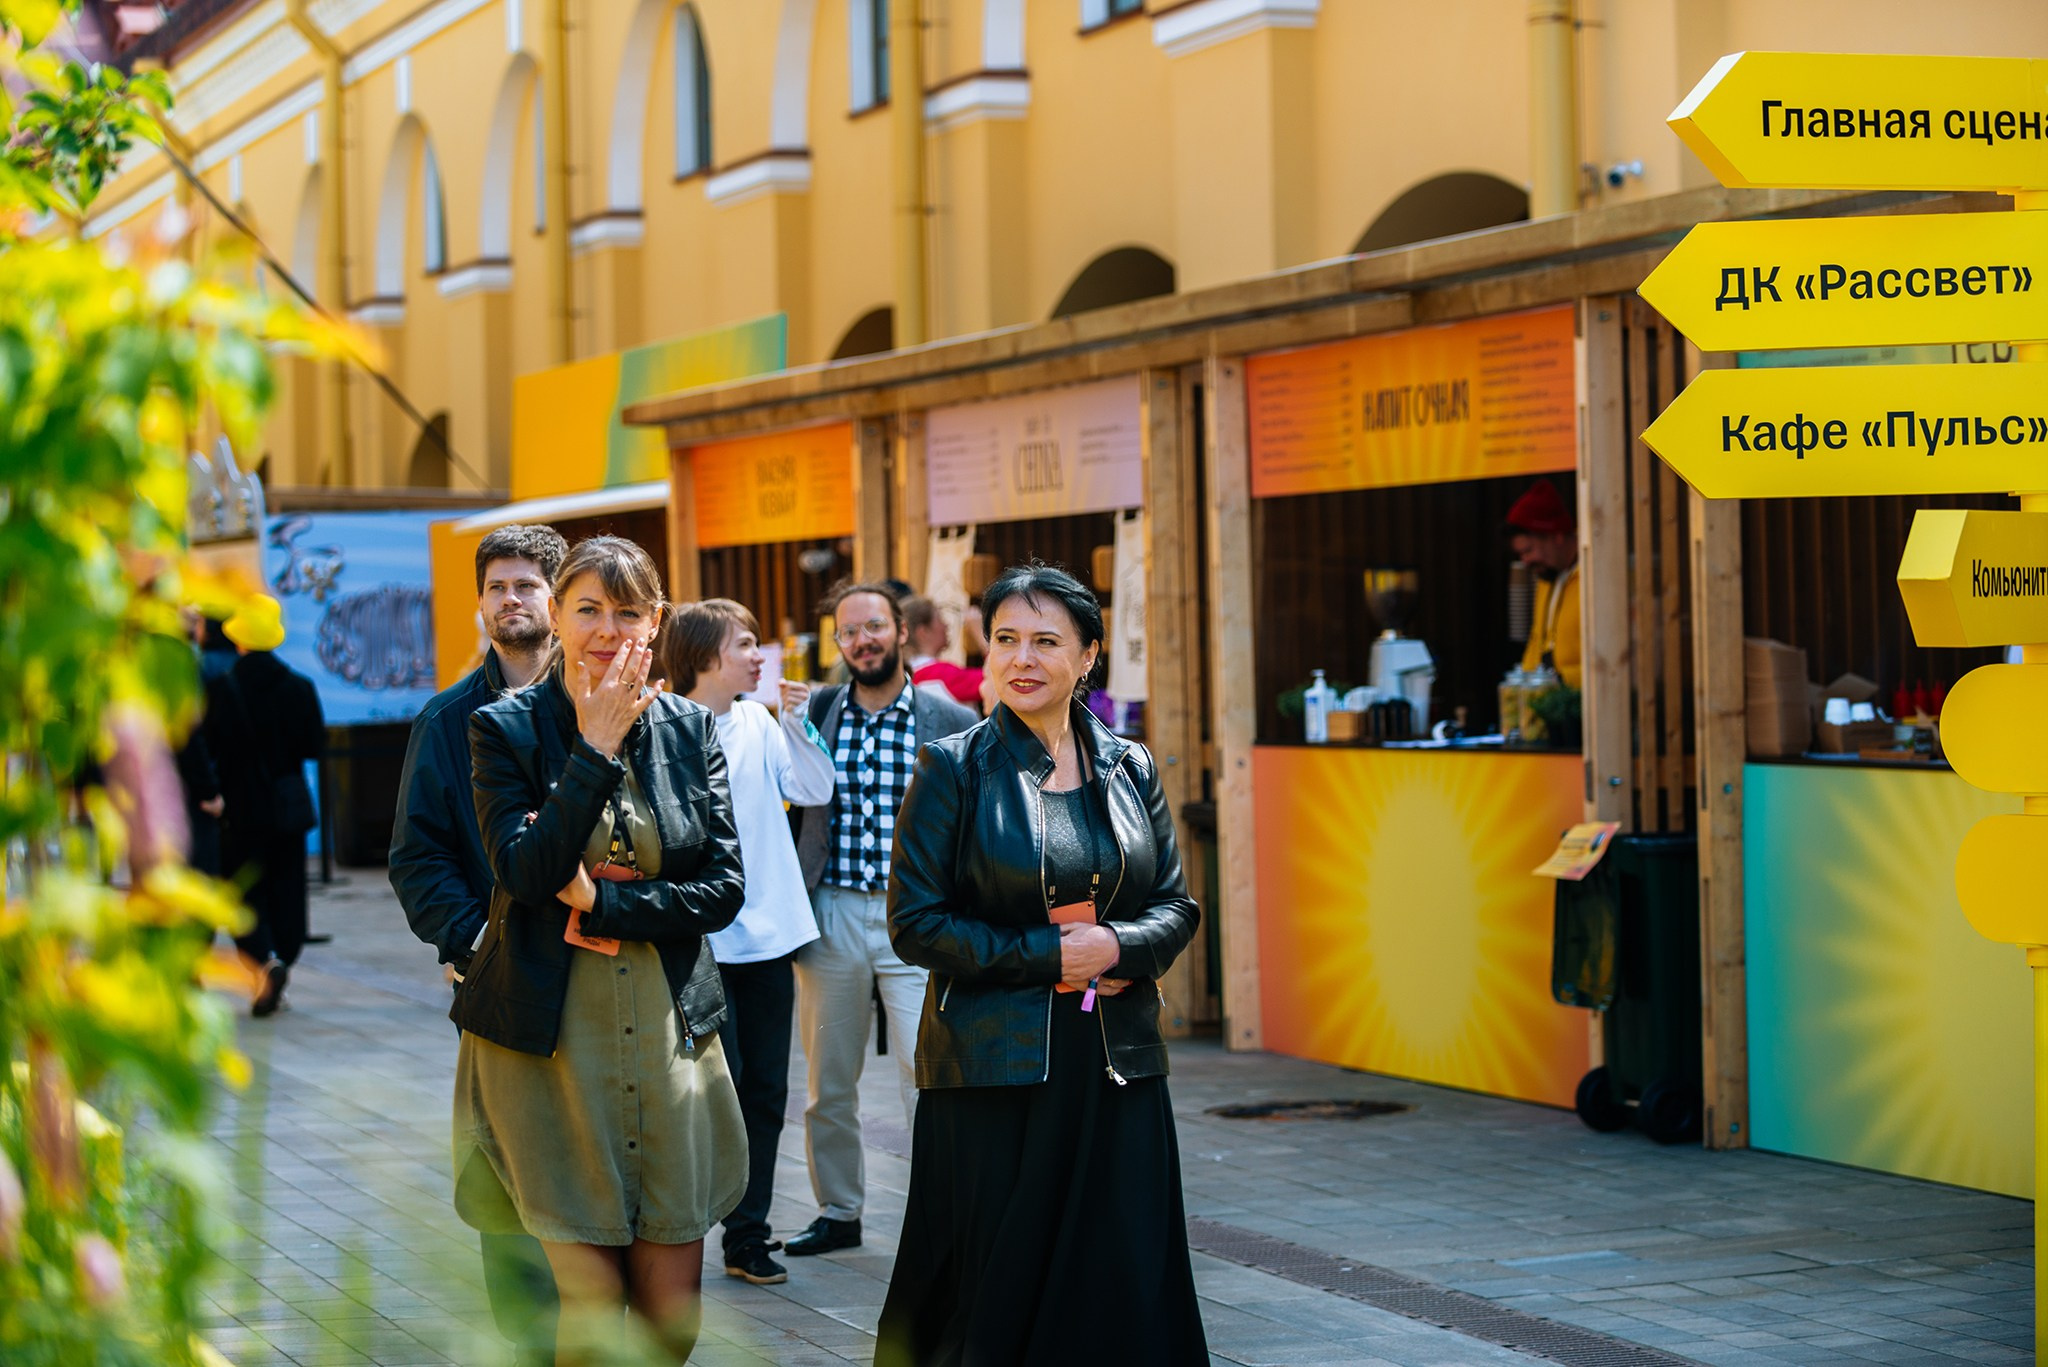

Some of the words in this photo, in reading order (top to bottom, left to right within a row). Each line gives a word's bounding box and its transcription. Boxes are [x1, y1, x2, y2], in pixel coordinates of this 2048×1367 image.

[1761, 100, 1931, 139] Главная
[1943, 109, 2048, 146] сцен
[1715, 266, 1783, 312] ДК
[1795, 264, 2033, 301] «Рассвет»
[1722, 413, 1848, 460] Кафе
[1861, 410, 2048, 457] «Пульс»
[1972, 559, 2048, 598] Комьюнит
